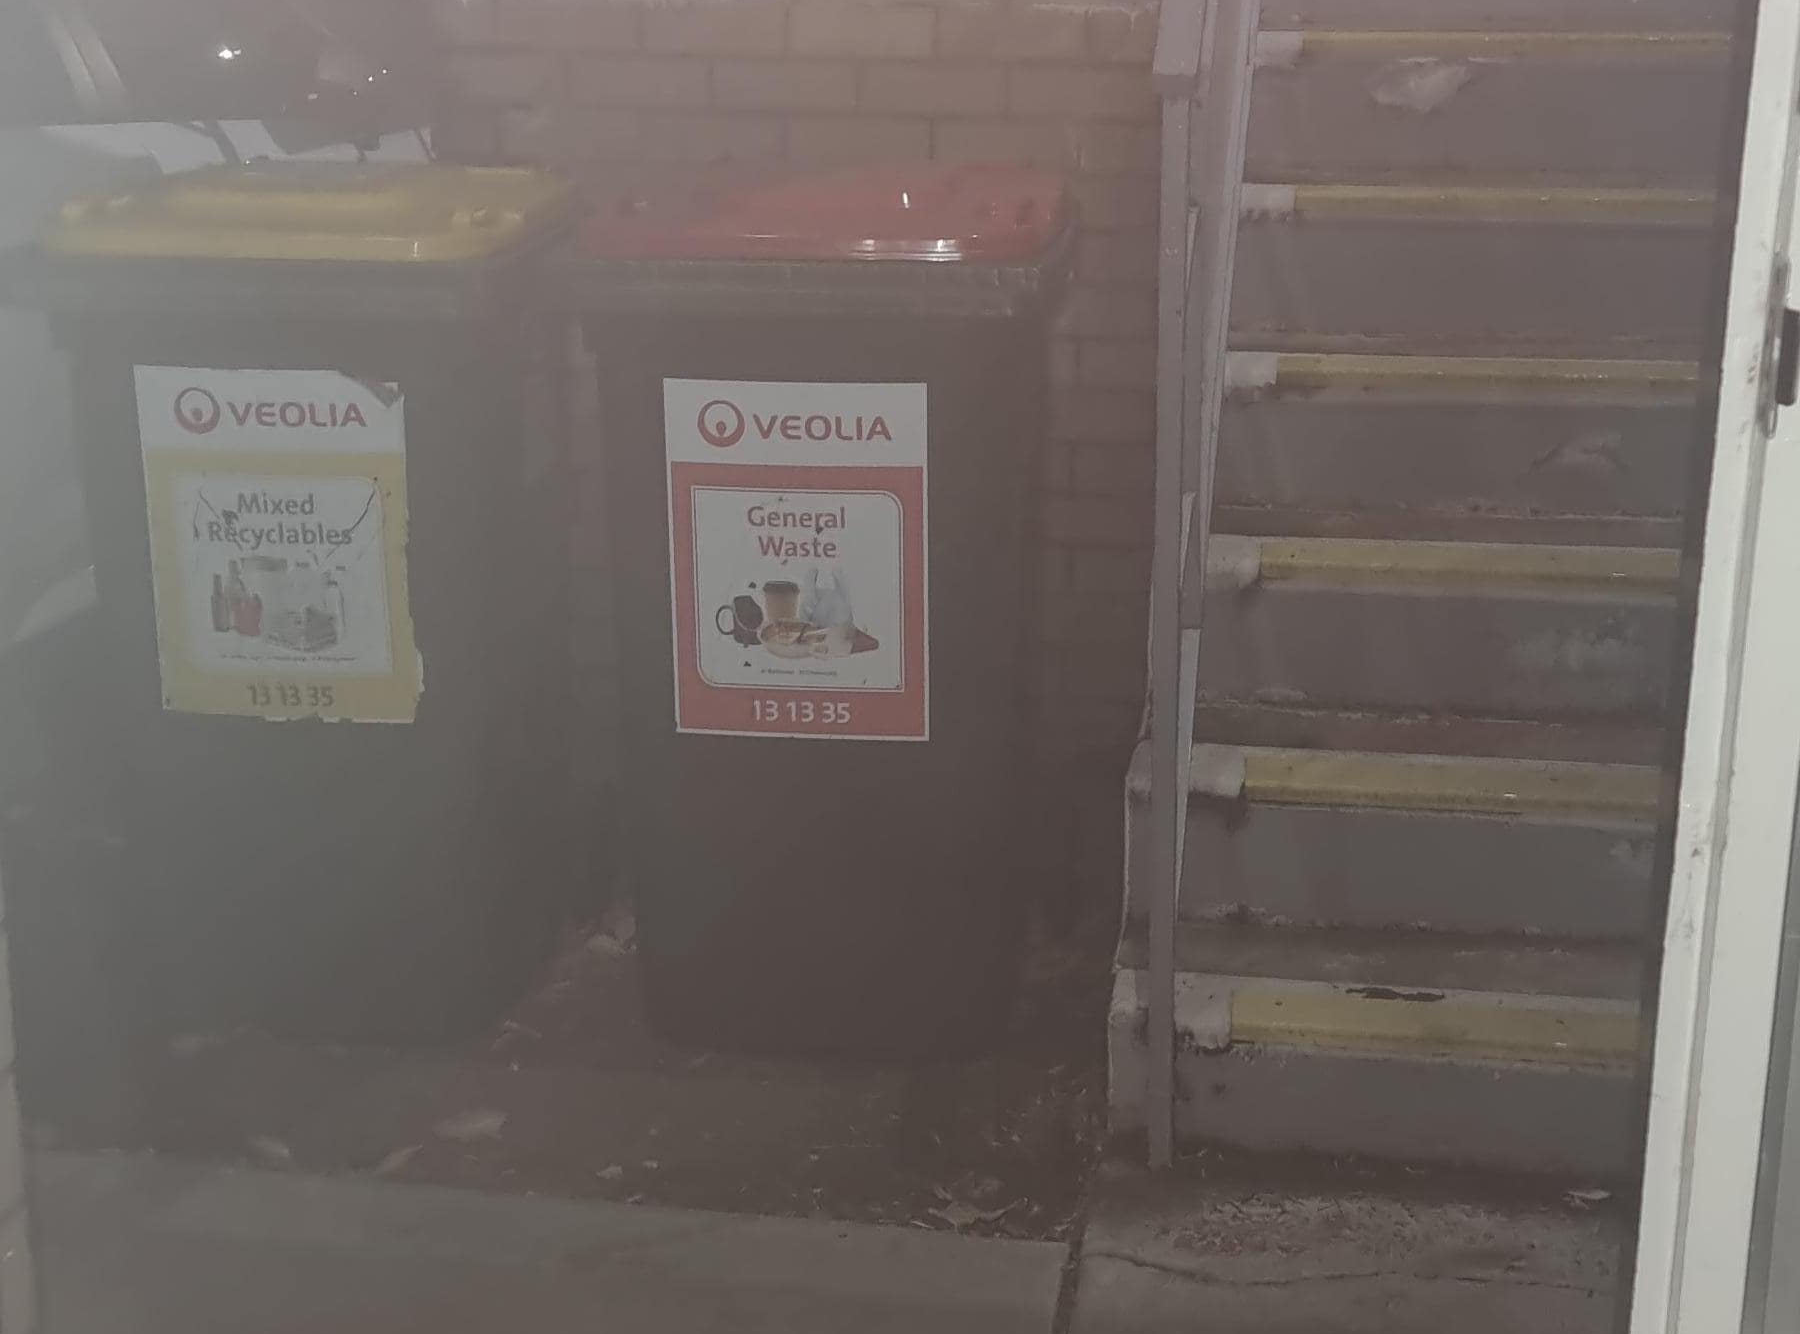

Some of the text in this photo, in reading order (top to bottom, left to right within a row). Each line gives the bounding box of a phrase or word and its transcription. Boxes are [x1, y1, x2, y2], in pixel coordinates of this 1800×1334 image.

[228, 401, 367, 427] VEOLIA
[753, 414, 892, 441] VEOLIA
[237, 492, 315, 517] Mixed
[747, 505, 847, 531] General
[208, 522, 353, 550] Recyclables
[758, 534, 837, 558] Waste
[247, 683, 335, 707] 13 13 35
[754, 700, 851, 724] 13 13 35
